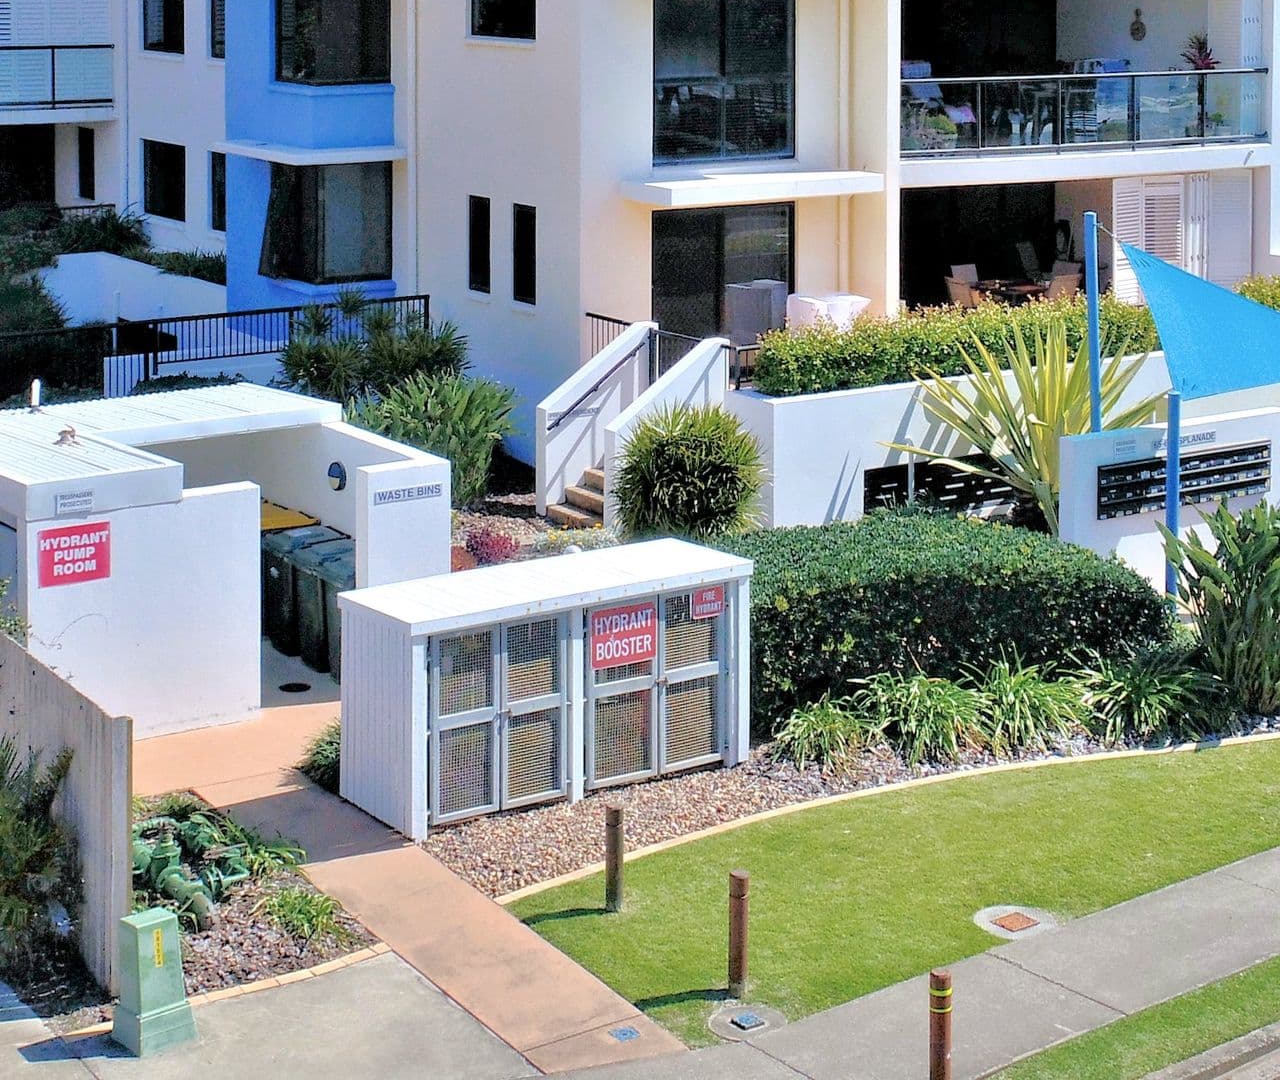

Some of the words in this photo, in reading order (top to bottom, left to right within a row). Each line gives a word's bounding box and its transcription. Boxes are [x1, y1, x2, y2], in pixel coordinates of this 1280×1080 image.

[1179, 431, 1216, 445] SPLANADE
[378, 487, 415, 502] WASTE
[417, 483, 441, 496] BINS
[40, 530, 109, 551] HYDRANT
[53, 546, 96, 563] PUMP
[53, 559, 97, 577] ROOM
[594, 609, 653, 635] HYDRANT
[596, 634, 652, 661] BOOSTER
